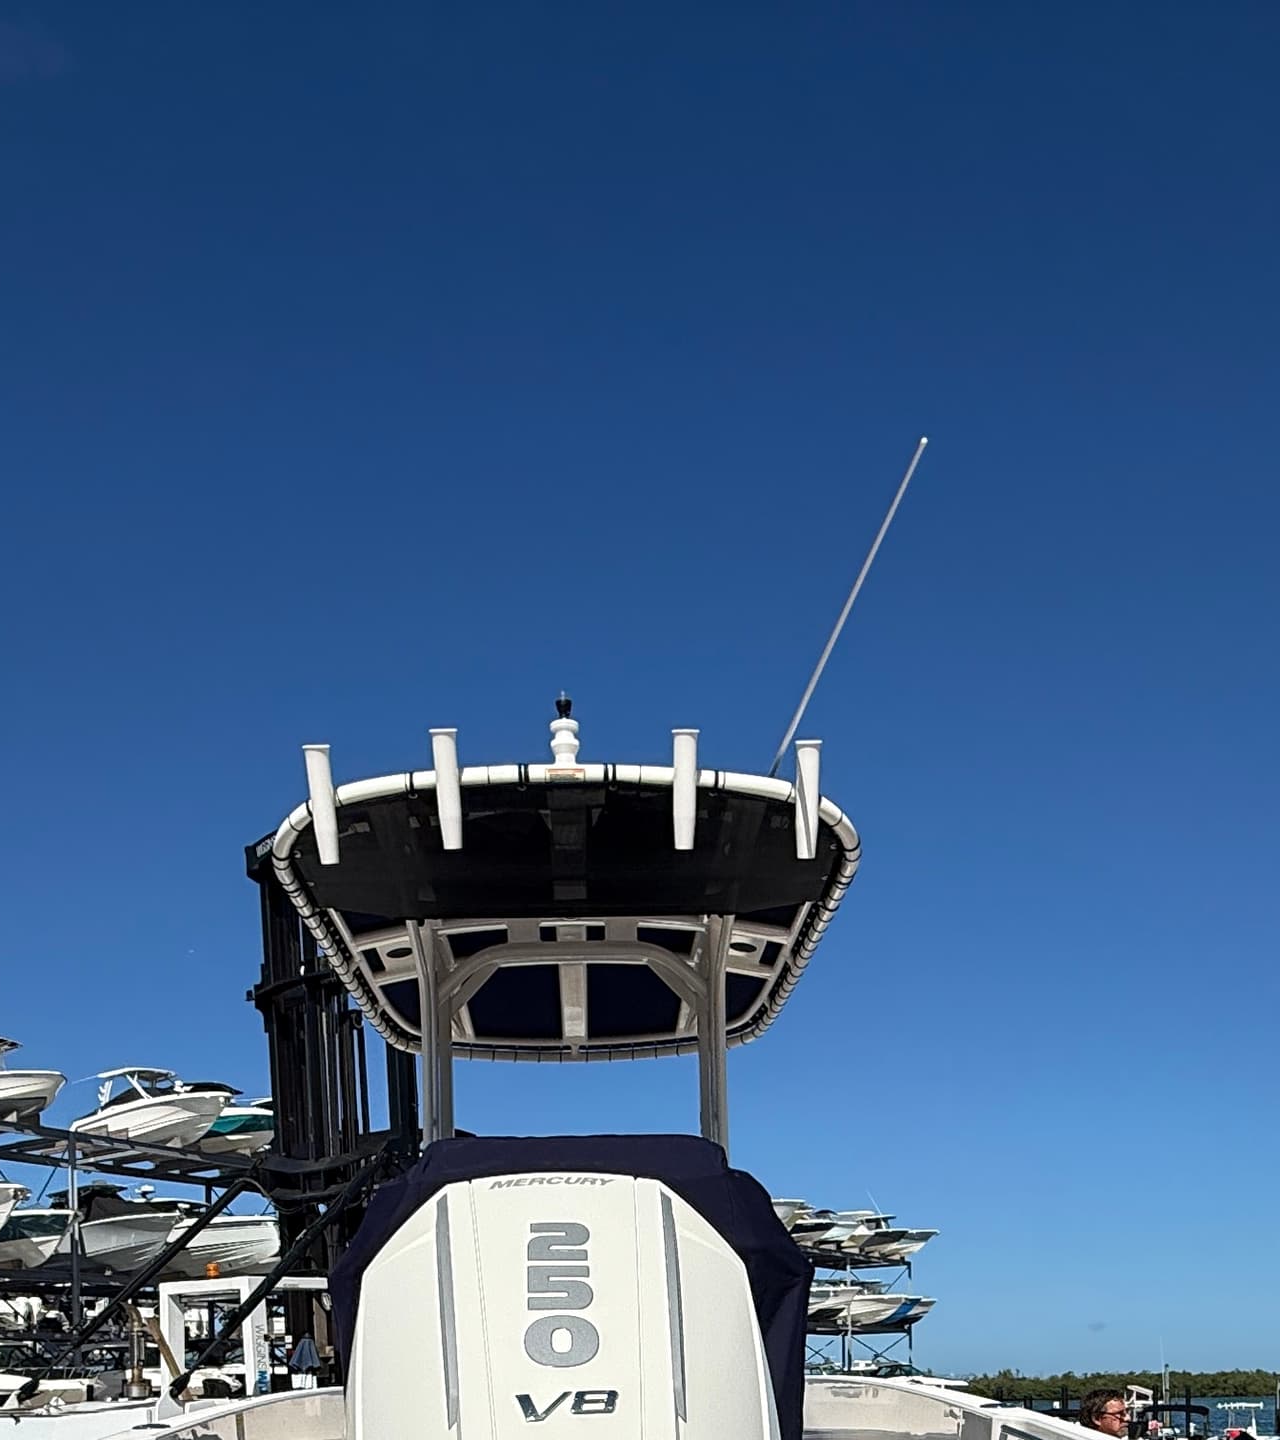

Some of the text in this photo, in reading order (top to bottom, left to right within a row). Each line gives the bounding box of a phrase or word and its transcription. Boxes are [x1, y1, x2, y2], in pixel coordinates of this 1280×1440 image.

[489, 1176, 616, 1190] MERCURY
[524, 1222, 600, 1368] 250
[254, 1324, 269, 1370] WIGGINS
[515, 1390, 619, 1423] V8
